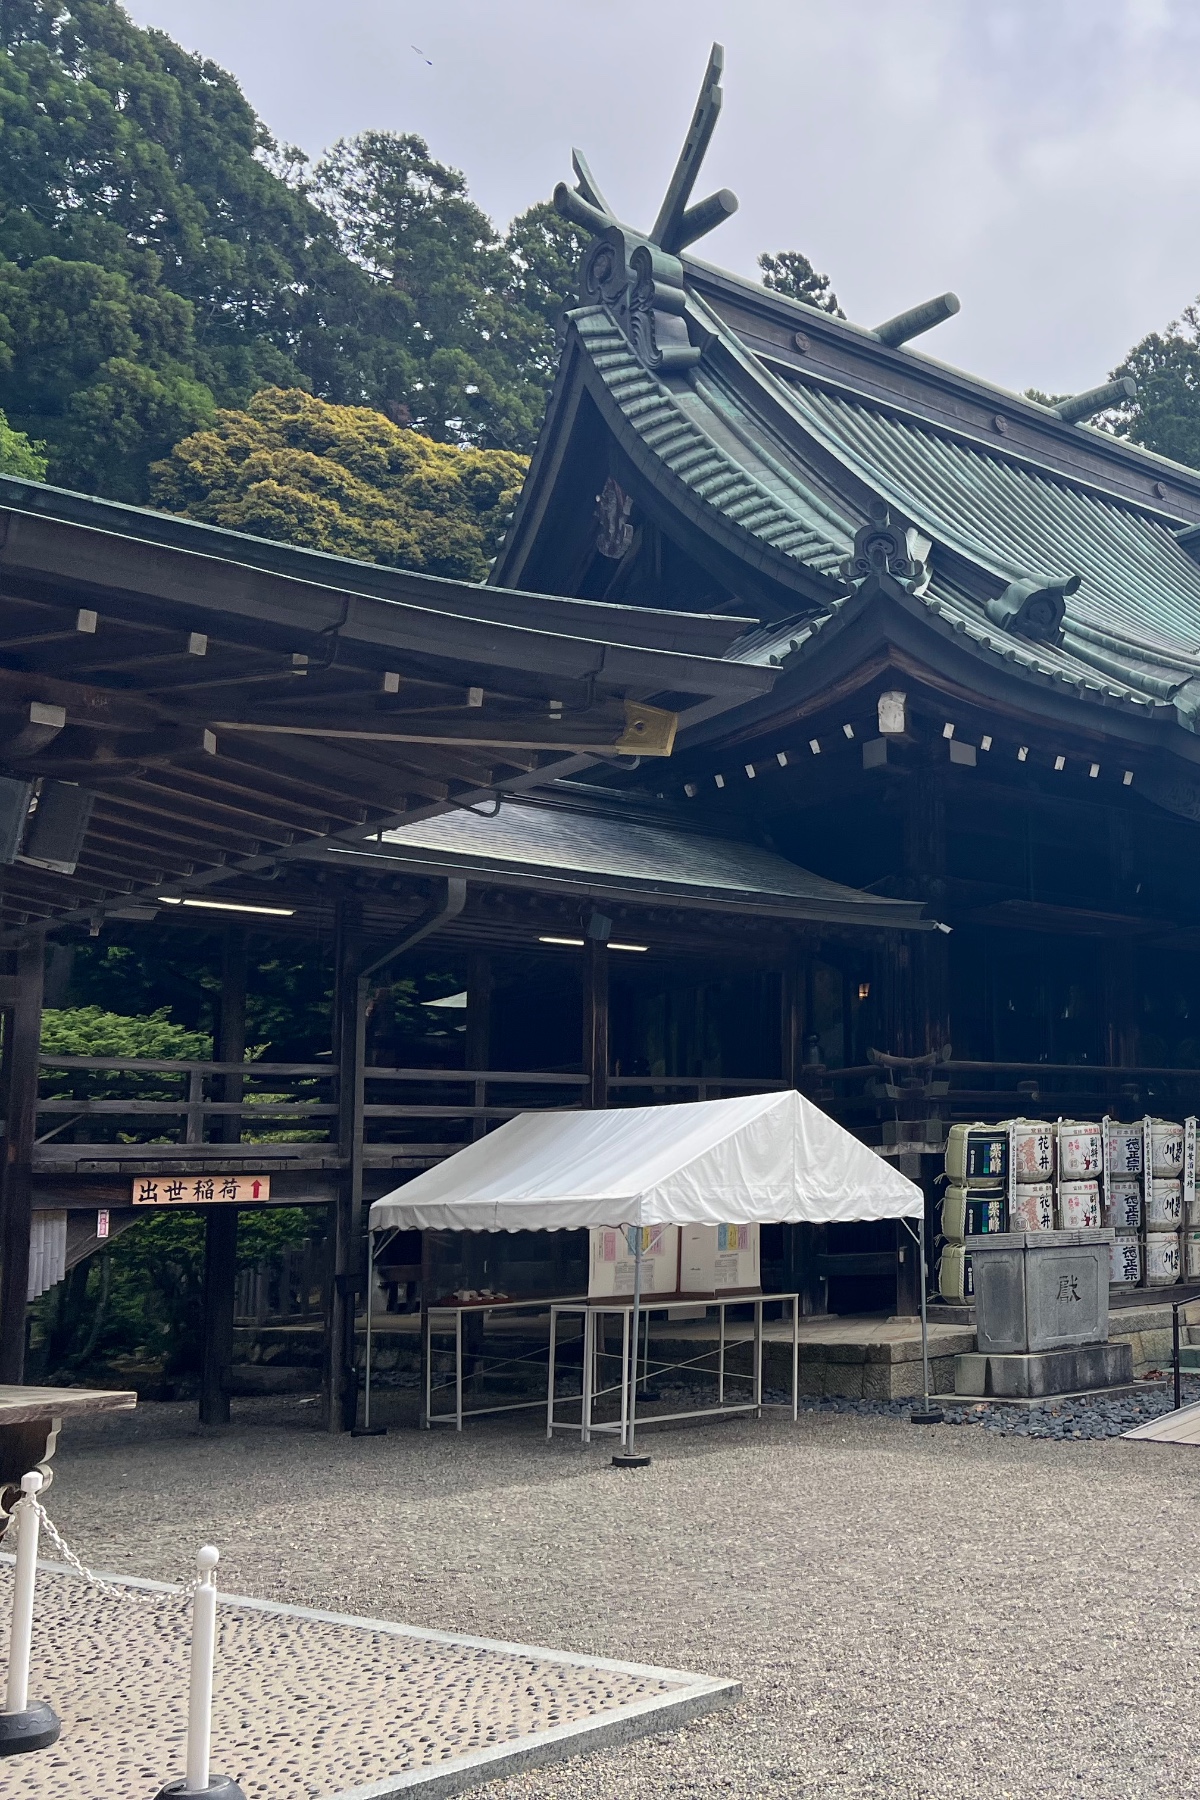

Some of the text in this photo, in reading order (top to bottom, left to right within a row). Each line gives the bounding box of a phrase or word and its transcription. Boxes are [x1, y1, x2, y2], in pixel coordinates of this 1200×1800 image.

[989, 1142, 1002, 1174] 紫峰
[1038, 1135, 1049, 1170] 花の井
[138, 1178, 241, 1203] 出世稲荷
[988, 1201, 1000, 1233] 紫峰
[1040, 1193, 1050, 1229] 花の井
